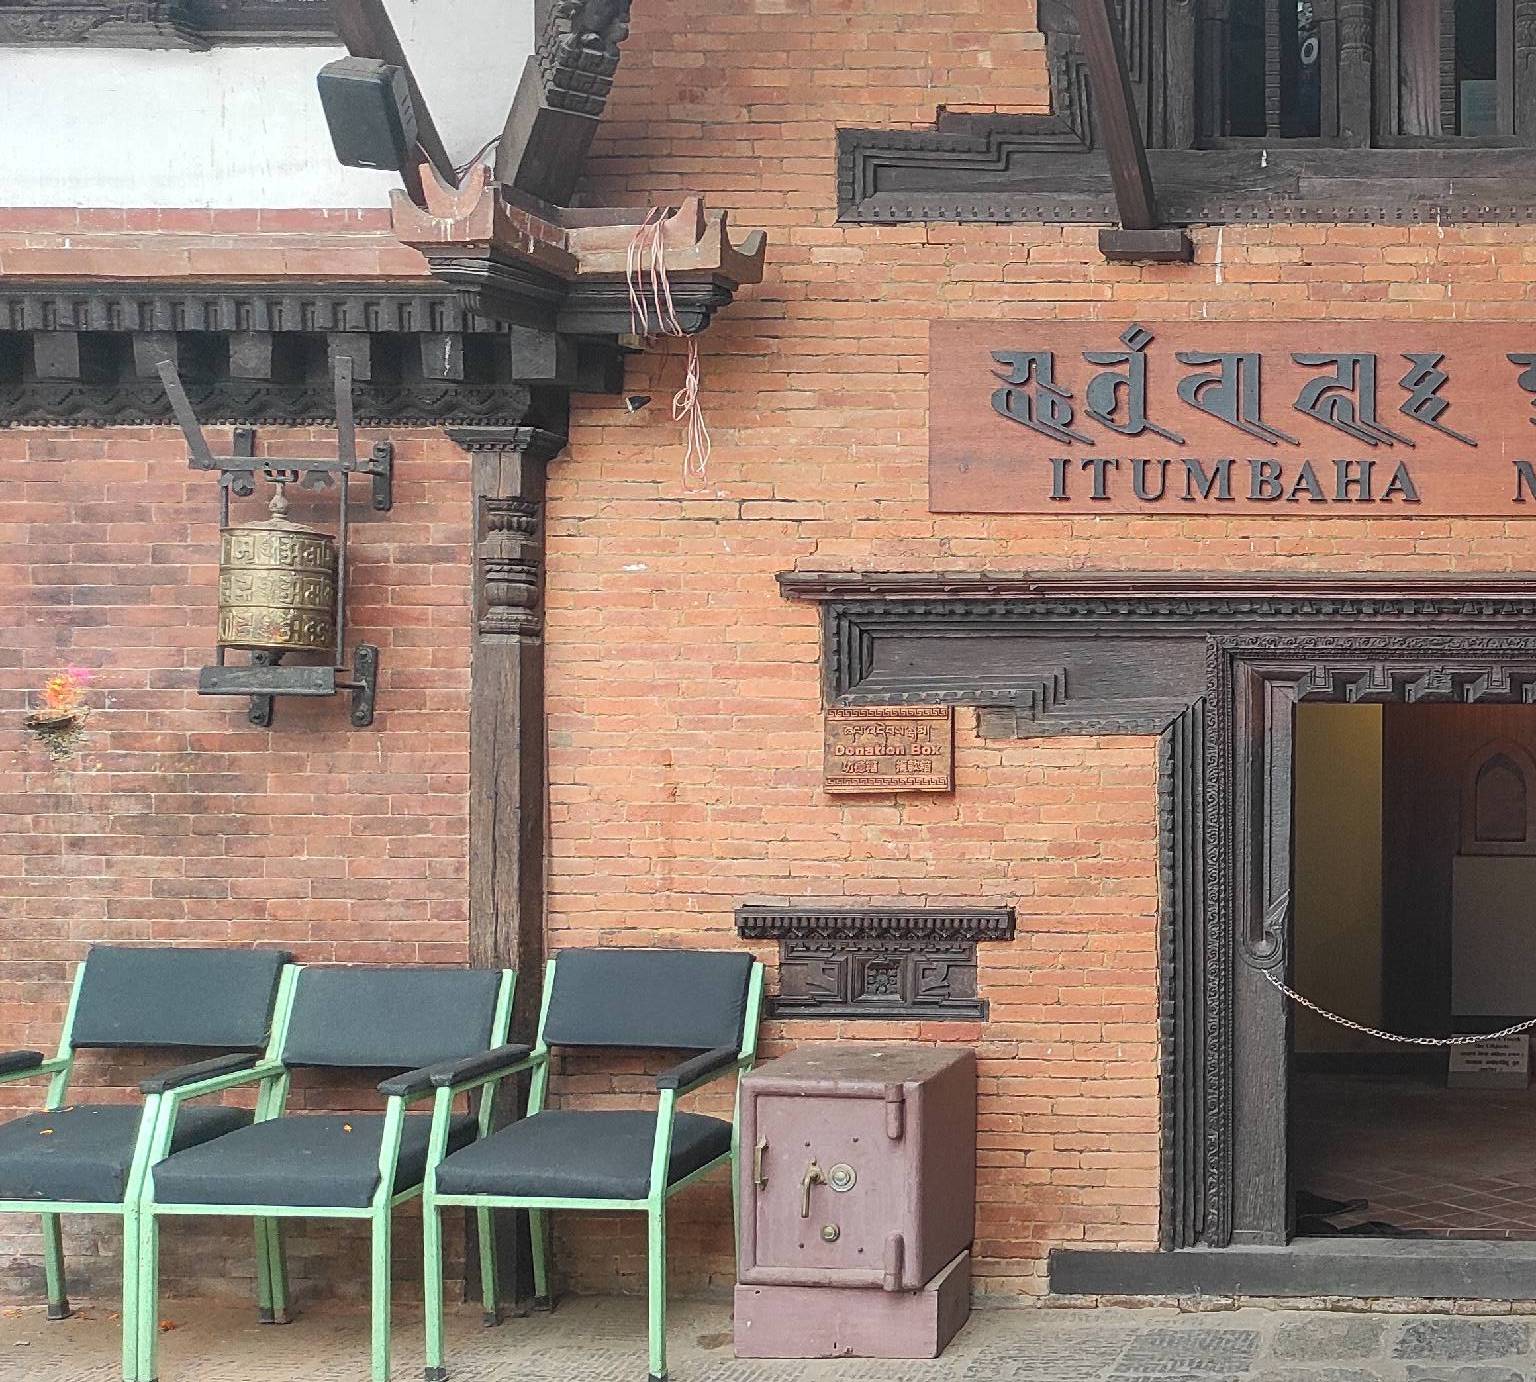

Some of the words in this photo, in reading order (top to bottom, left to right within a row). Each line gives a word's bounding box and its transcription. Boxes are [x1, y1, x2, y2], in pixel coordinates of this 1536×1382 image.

[1048, 457, 1422, 502] ITUMBAHA
[835, 744, 906, 756] Donation
[910, 743, 943, 756] Box
